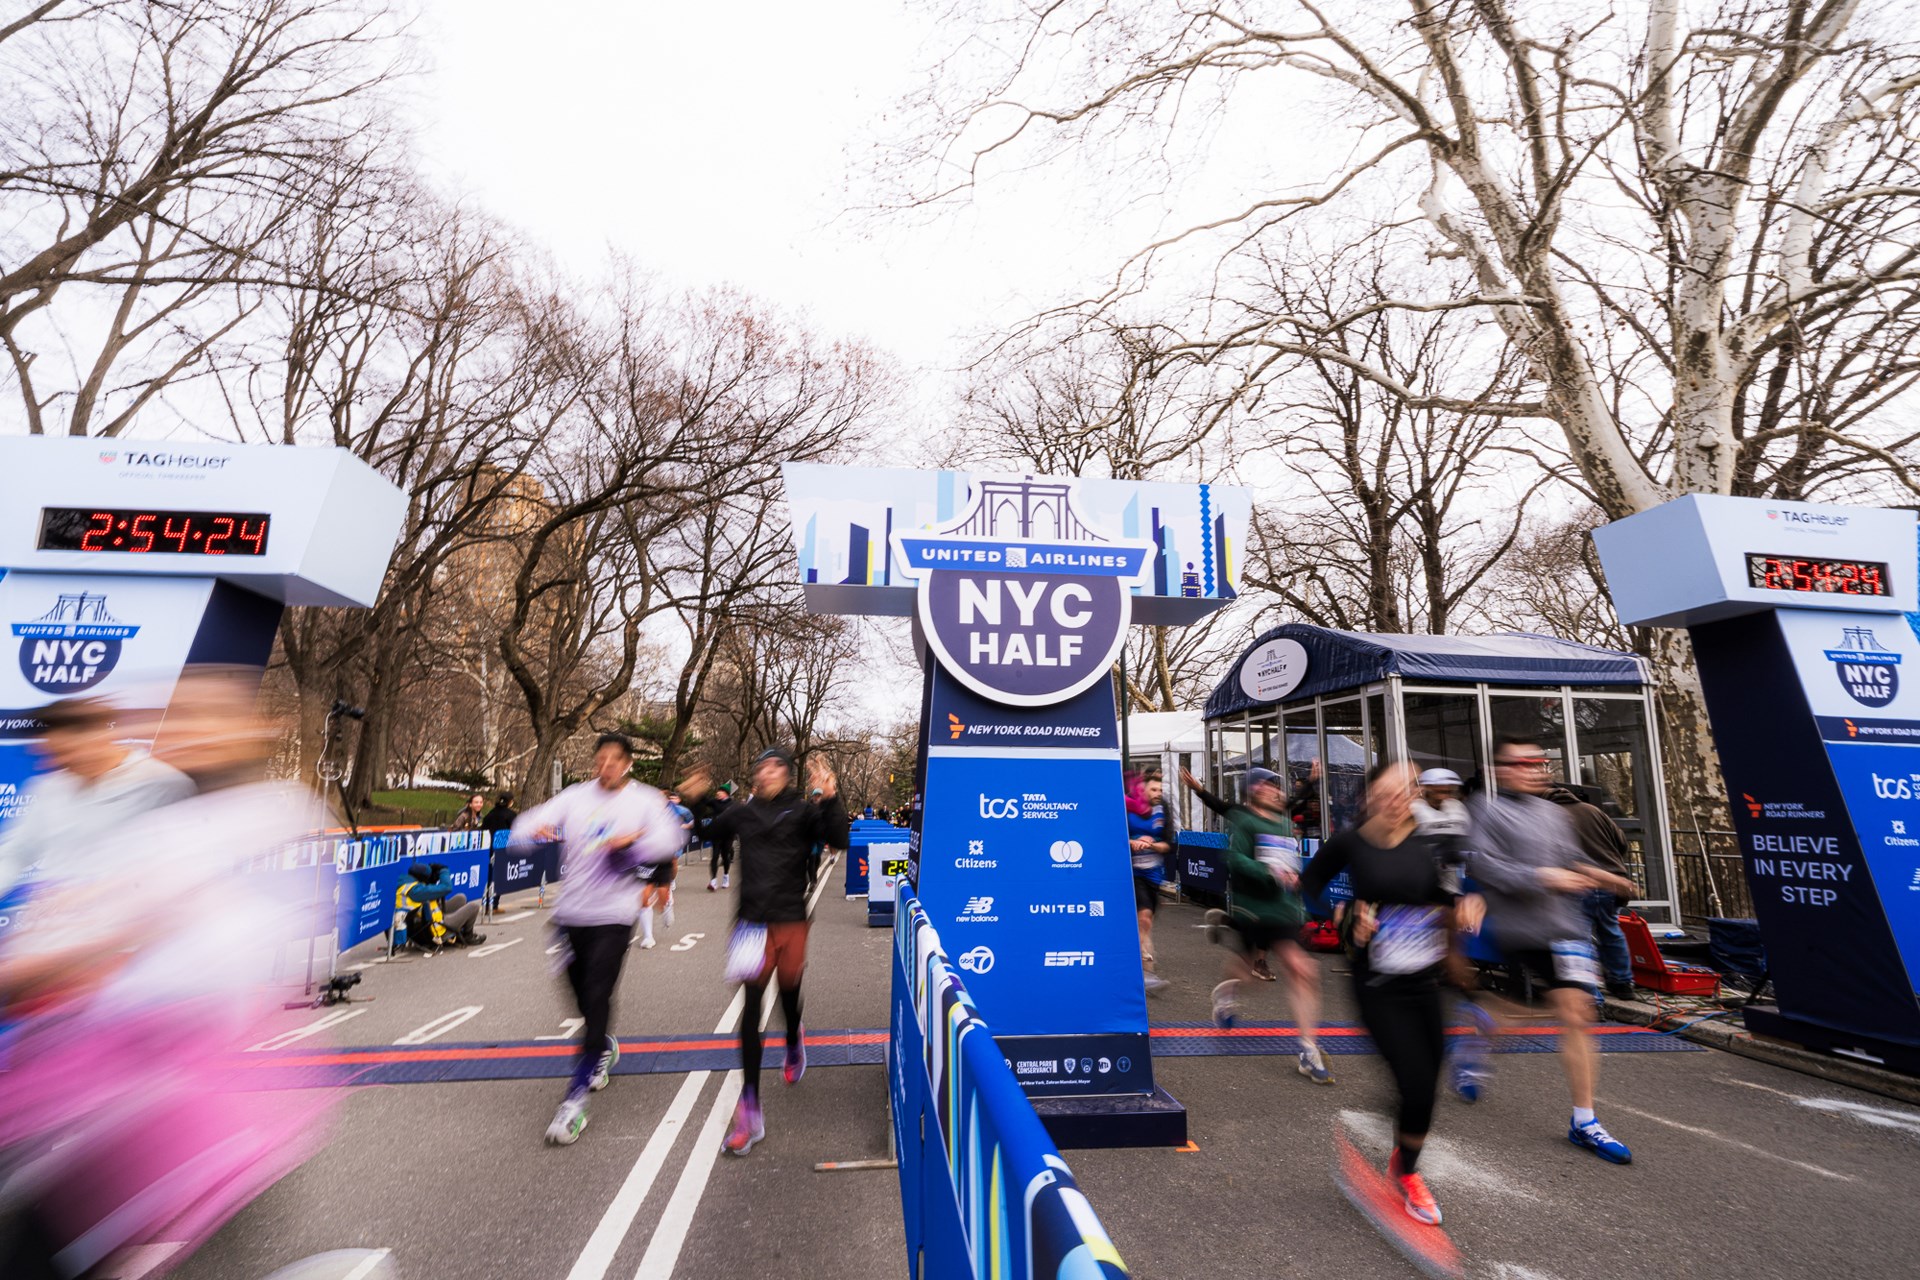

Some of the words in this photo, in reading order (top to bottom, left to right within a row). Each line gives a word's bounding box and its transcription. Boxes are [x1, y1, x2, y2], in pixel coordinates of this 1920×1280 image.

[921, 548, 1002, 563] UNITED
[1030, 552, 1128, 568] AIRLINES
[959, 578, 1093, 628] NYC
[19, 626, 63, 635] UNITED
[76, 627, 130, 637] AIRLINES
[31, 639, 107, 666] NYC
[969, 632, 1083, 667] HALF
[33, 665, 98, 684] HALF
[1843, 664, 1891, 685] NYC
[1851, 684, 1891, 699] HALF
[967, 725, 993, 735] NEW
[993, 725, 1023, 736] YORK
[1023, 726, 1054, 736] ROAD
[1053, 727, 1101, 737] RUNNERS
[1858, 727, 1876, 735] NEW
[1875, 727, 1893, 736] YORK
[1871, 772, 1912, 800] tcs
[1022, 793, 1047, 801] TATA
[979, 793, 1019, 819] tcs
[1022, 802, 1079, 811] CONSULTANCY
[1782, 803, 1804, 811] YORK
[1022, 811, 1059, 820] SERVICES
[1765, 810, 1787, 818] ROAD
[1788, 811, 1826, 819] RUNNERS
[1752, 834, 1840, 855] BELIEVE
[1884, 836, 1920, 846] Citizens
[954, 858, 997, 868] Citizens
[1754, 858, 1776, 876] IN
[1780, 860, 1853, 881] EVERY
[1781, 885, 1838, 906] STEP
[1029, 904, 1087, 914] UNITED
[1044, 951, 1095, 967] ESPN
